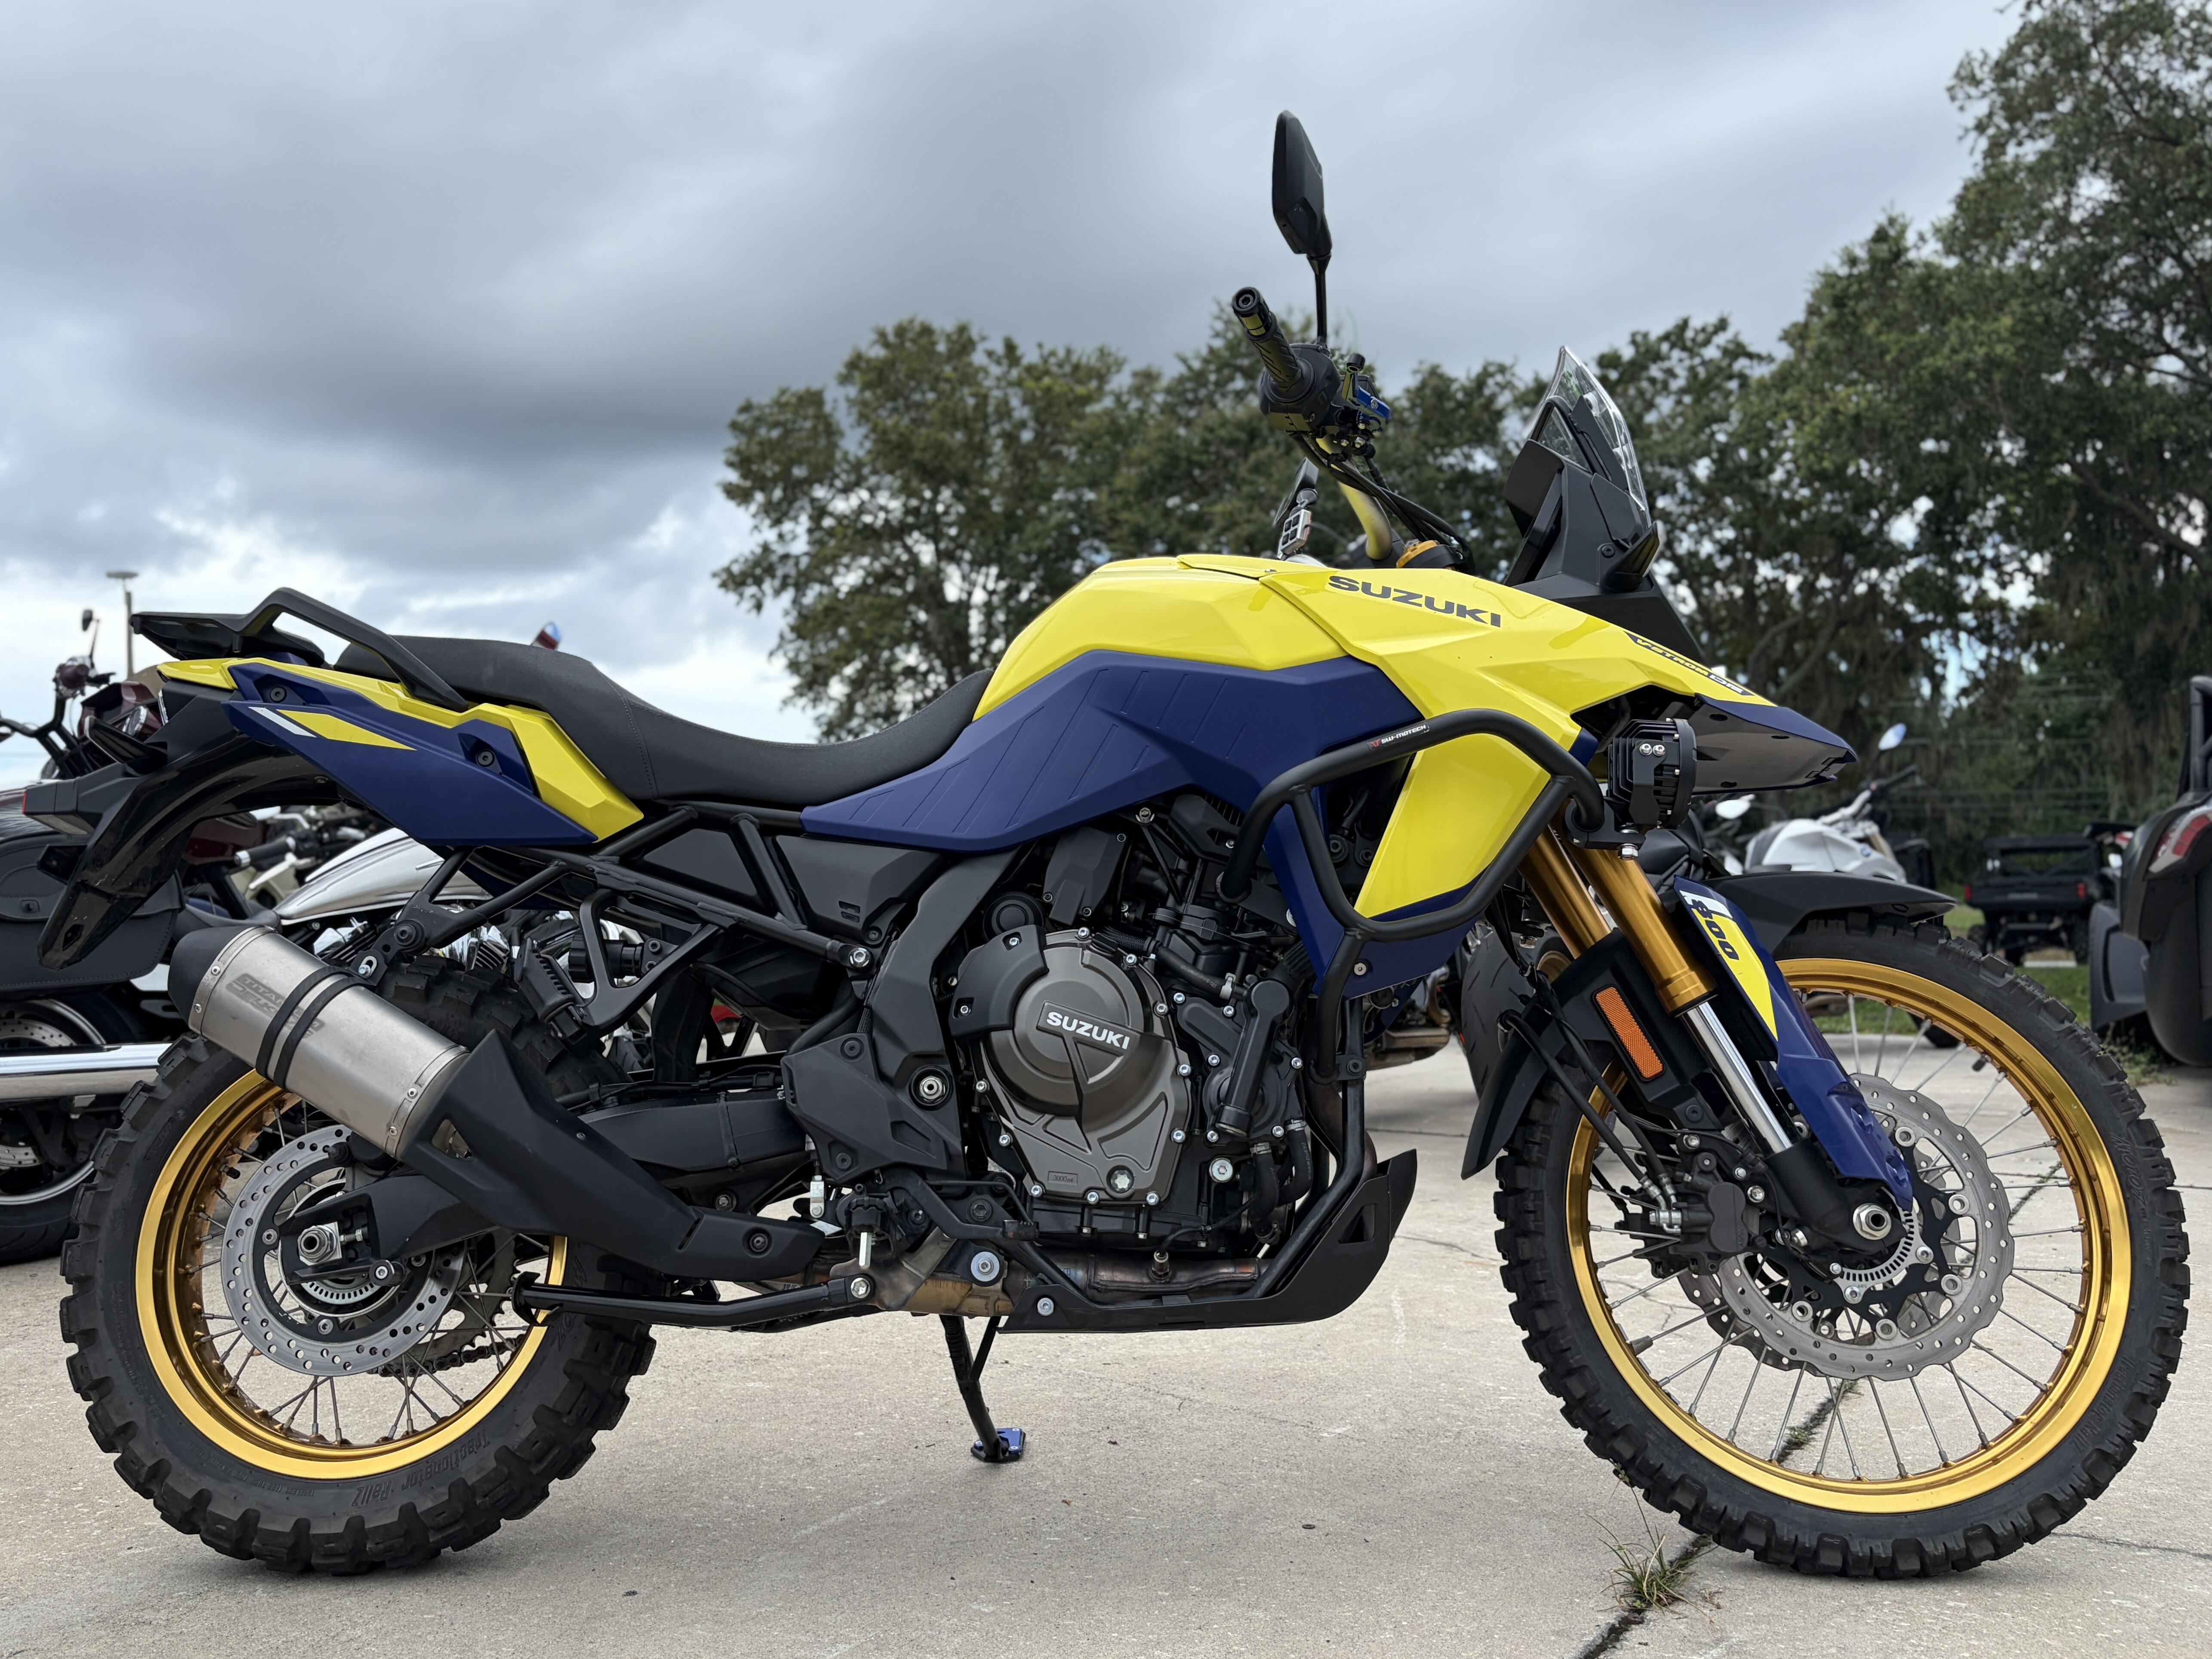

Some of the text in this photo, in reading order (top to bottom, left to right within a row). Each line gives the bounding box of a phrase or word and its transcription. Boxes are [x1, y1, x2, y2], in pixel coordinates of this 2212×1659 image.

[1328, 576, 1501, 627] SUZUKI
[1381, 725, 1426, 744] SW-MOTECH
[1690, 898, 1740, 961] 800
[1046, 1011, 1130, 1050] SUZUKI
[401, 1428, 491, 1491] Tractionator
[285, 1488, 315, 1497] TUBELESS
